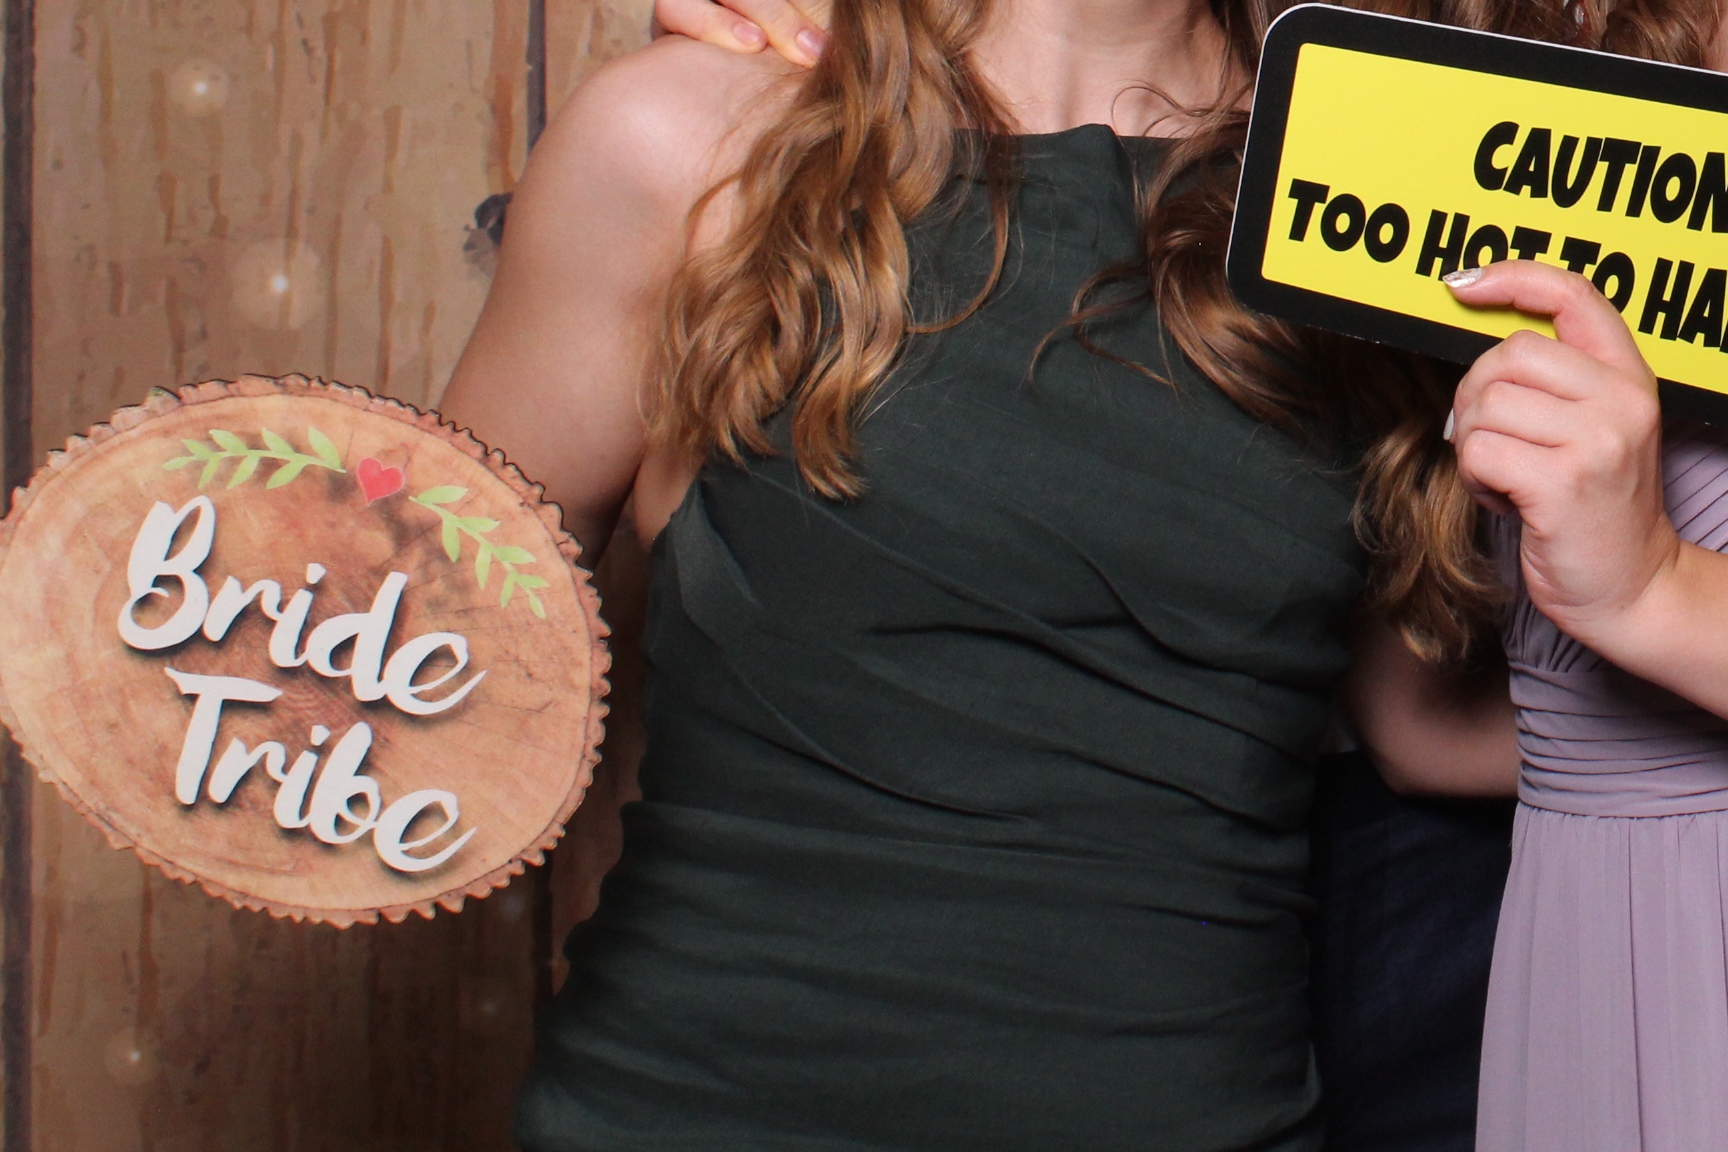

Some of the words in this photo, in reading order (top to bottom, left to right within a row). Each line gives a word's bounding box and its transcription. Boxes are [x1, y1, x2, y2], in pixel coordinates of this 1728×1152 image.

[1288, 178, 1410, 263] TOO
[1414, 209, 1553, 282] HOT
[1559, 235, 1636, 314] TO
[118, 495, 488, 715] Bride
[165, 666, 477, 872] Tribe
